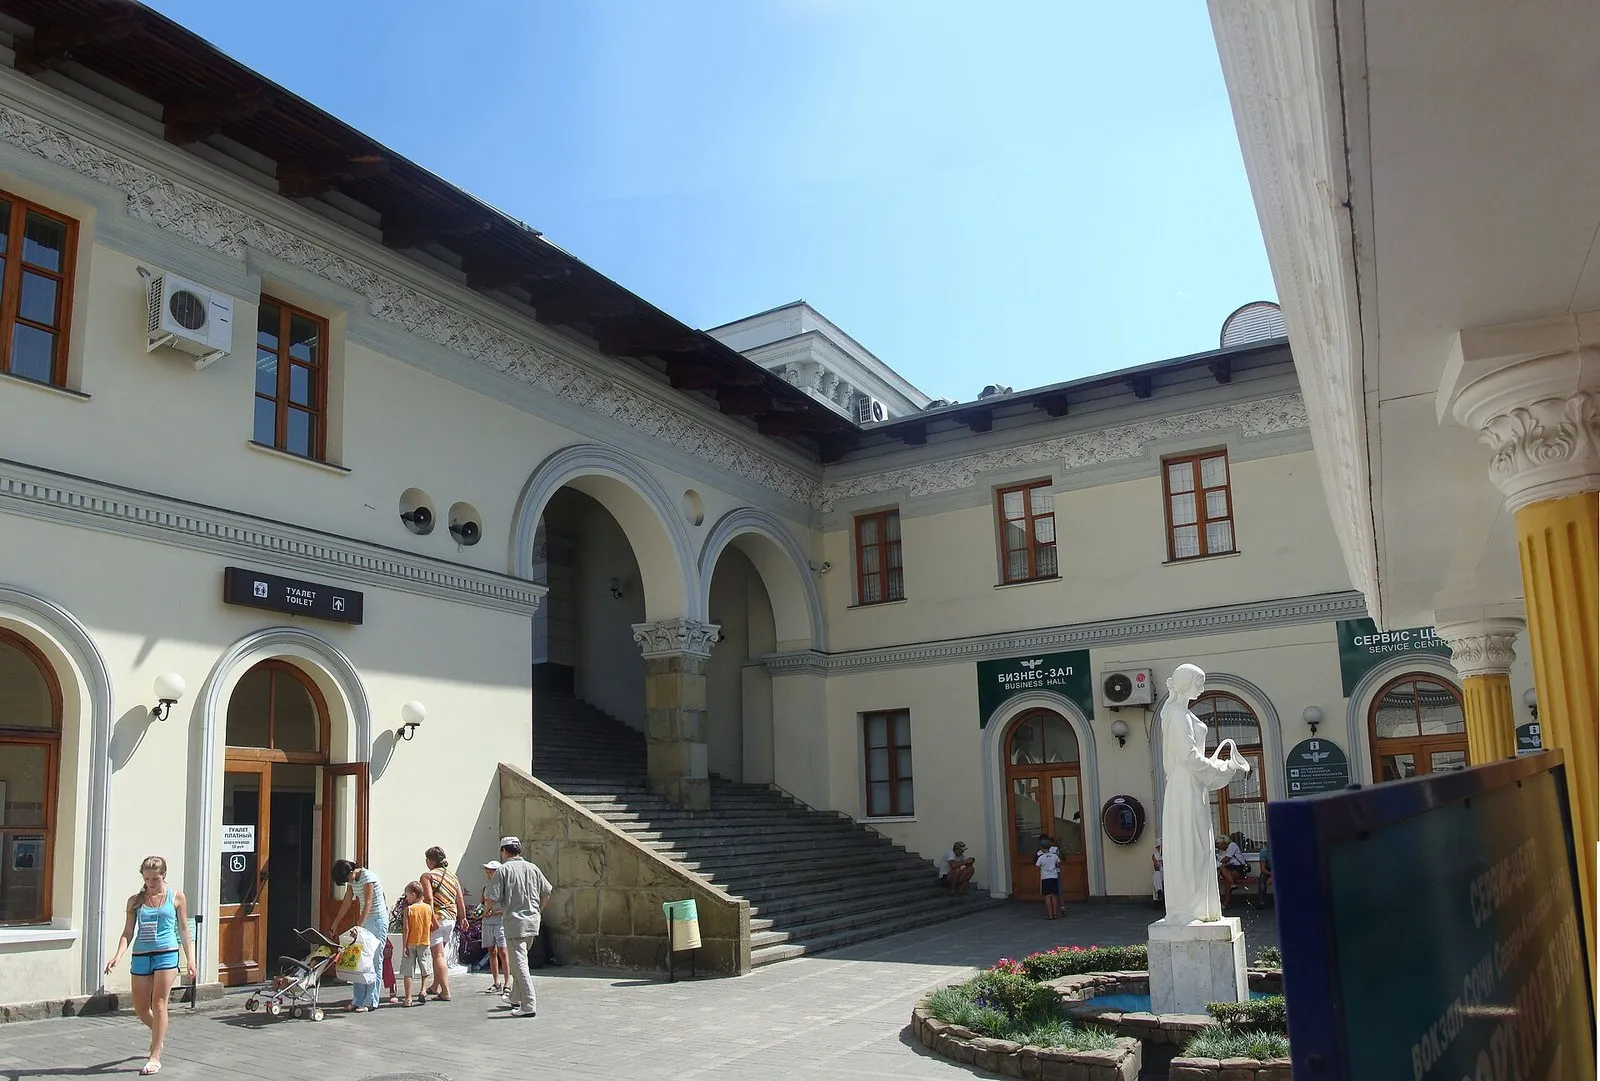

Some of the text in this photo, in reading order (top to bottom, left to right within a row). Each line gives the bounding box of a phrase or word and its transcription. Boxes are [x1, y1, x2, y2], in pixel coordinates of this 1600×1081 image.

[286, 586, 317, 599] ТУАЛЕТ
[285, 595, 314, 607] TOILET
[1369, 639, 1448, 655] SERVICE CENTR
[998, 666, 1073, 683] БИЗНЕС-ЗАЛ
[1004, 677, 1067, 691] BUSINESS HALL
